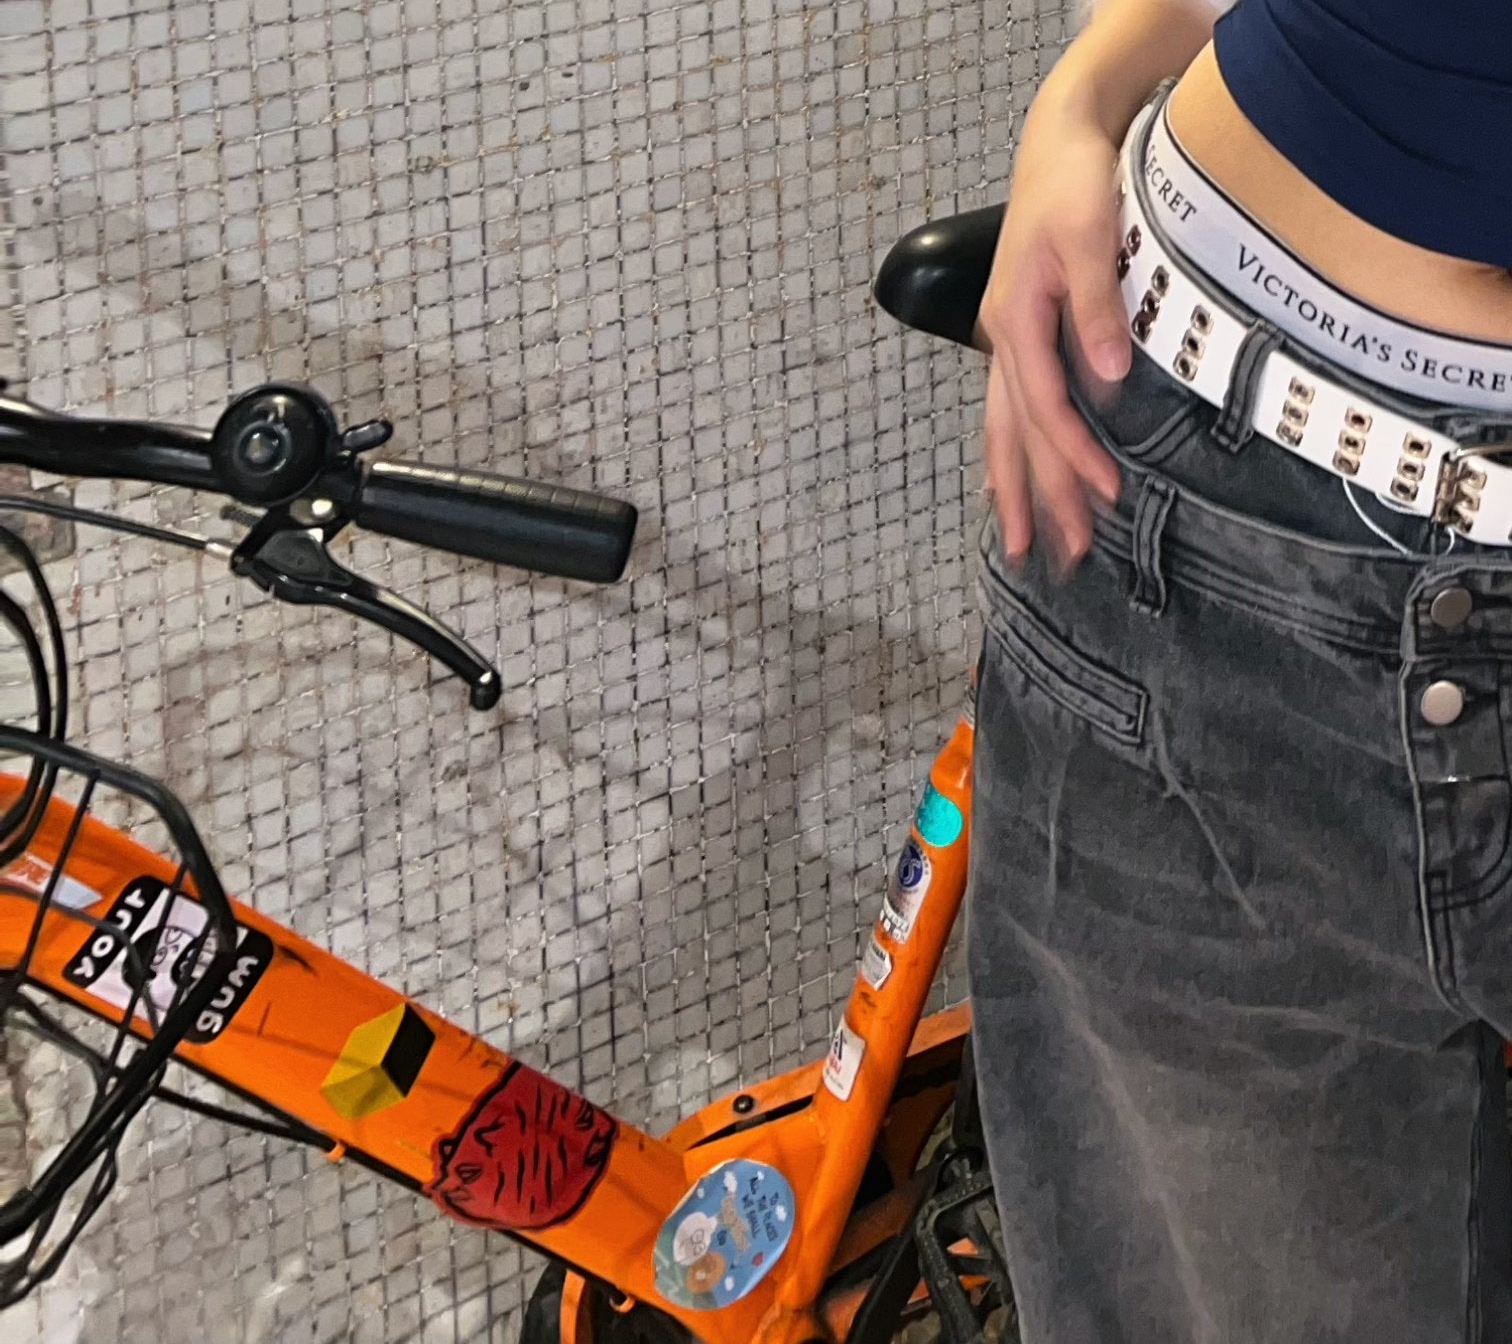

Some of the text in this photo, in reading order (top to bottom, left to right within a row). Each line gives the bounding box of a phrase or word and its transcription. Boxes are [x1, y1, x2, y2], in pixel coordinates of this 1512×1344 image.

[1145, 144, 1197, 222] ECRET
[1236, 243, 1393, 363] VICTORIA'S
[73, 888, 146, 979] your
[196, 955, 260, 1035] gum
